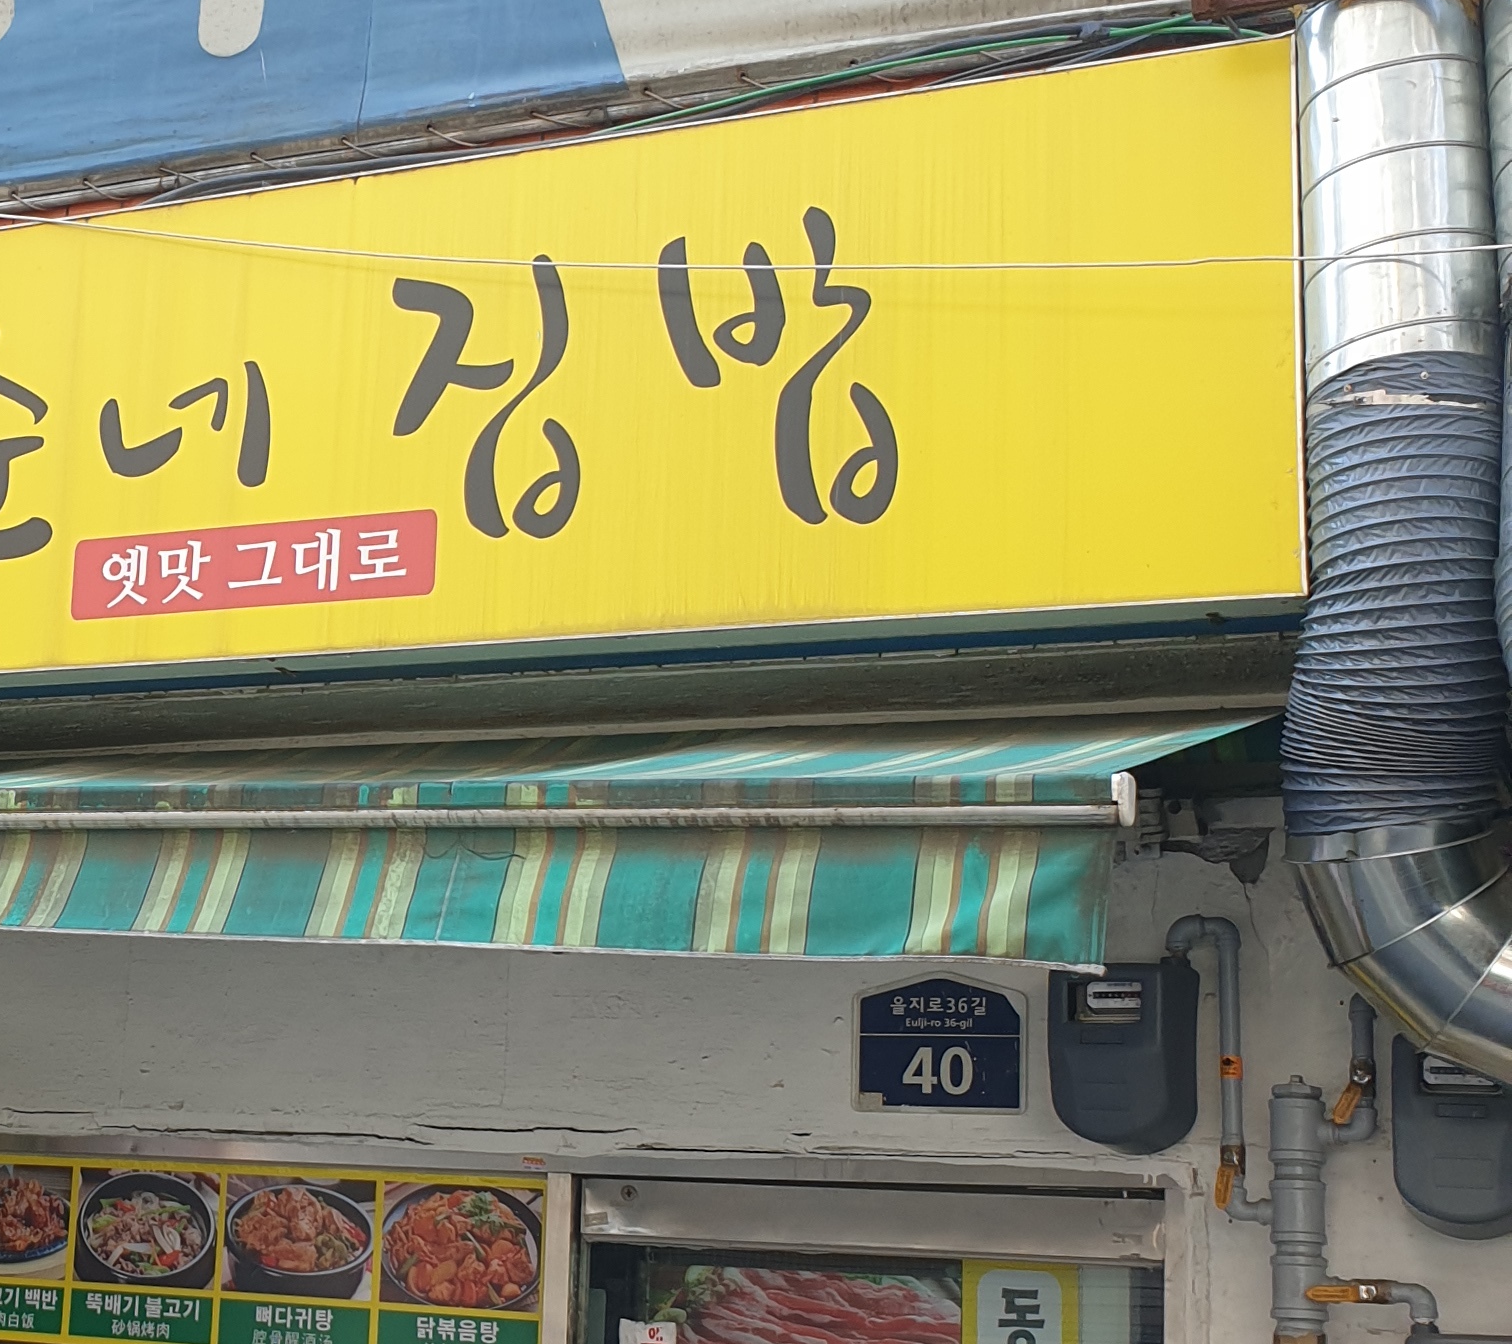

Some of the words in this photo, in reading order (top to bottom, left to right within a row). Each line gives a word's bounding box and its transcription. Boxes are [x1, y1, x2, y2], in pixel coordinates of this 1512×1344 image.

[392, 206, 900, 539] 집밥
[99, 538, 212, 610] 옛맛
[226, 524, 410, 592] 그대로
[890, 996, 987, 1016] 을지로36길
[905, 1017, 942, 1029] Eulji-ro
[943, 1018, 973, 1030] 36-gil
[902, 1046, 974, 1095] 40
[24, 1289, 59, 1312] 백반
[85, 1292, 139, 1316] 뚝배기
[144, 1296, 200, 1322] 불고기
[110, 1319, 170, 1340] 砂锅烤肉
[255, 1305, 333, 1332] 뼈다귀탕
[416, 1316, 500, 1344] 닭볶음탕
